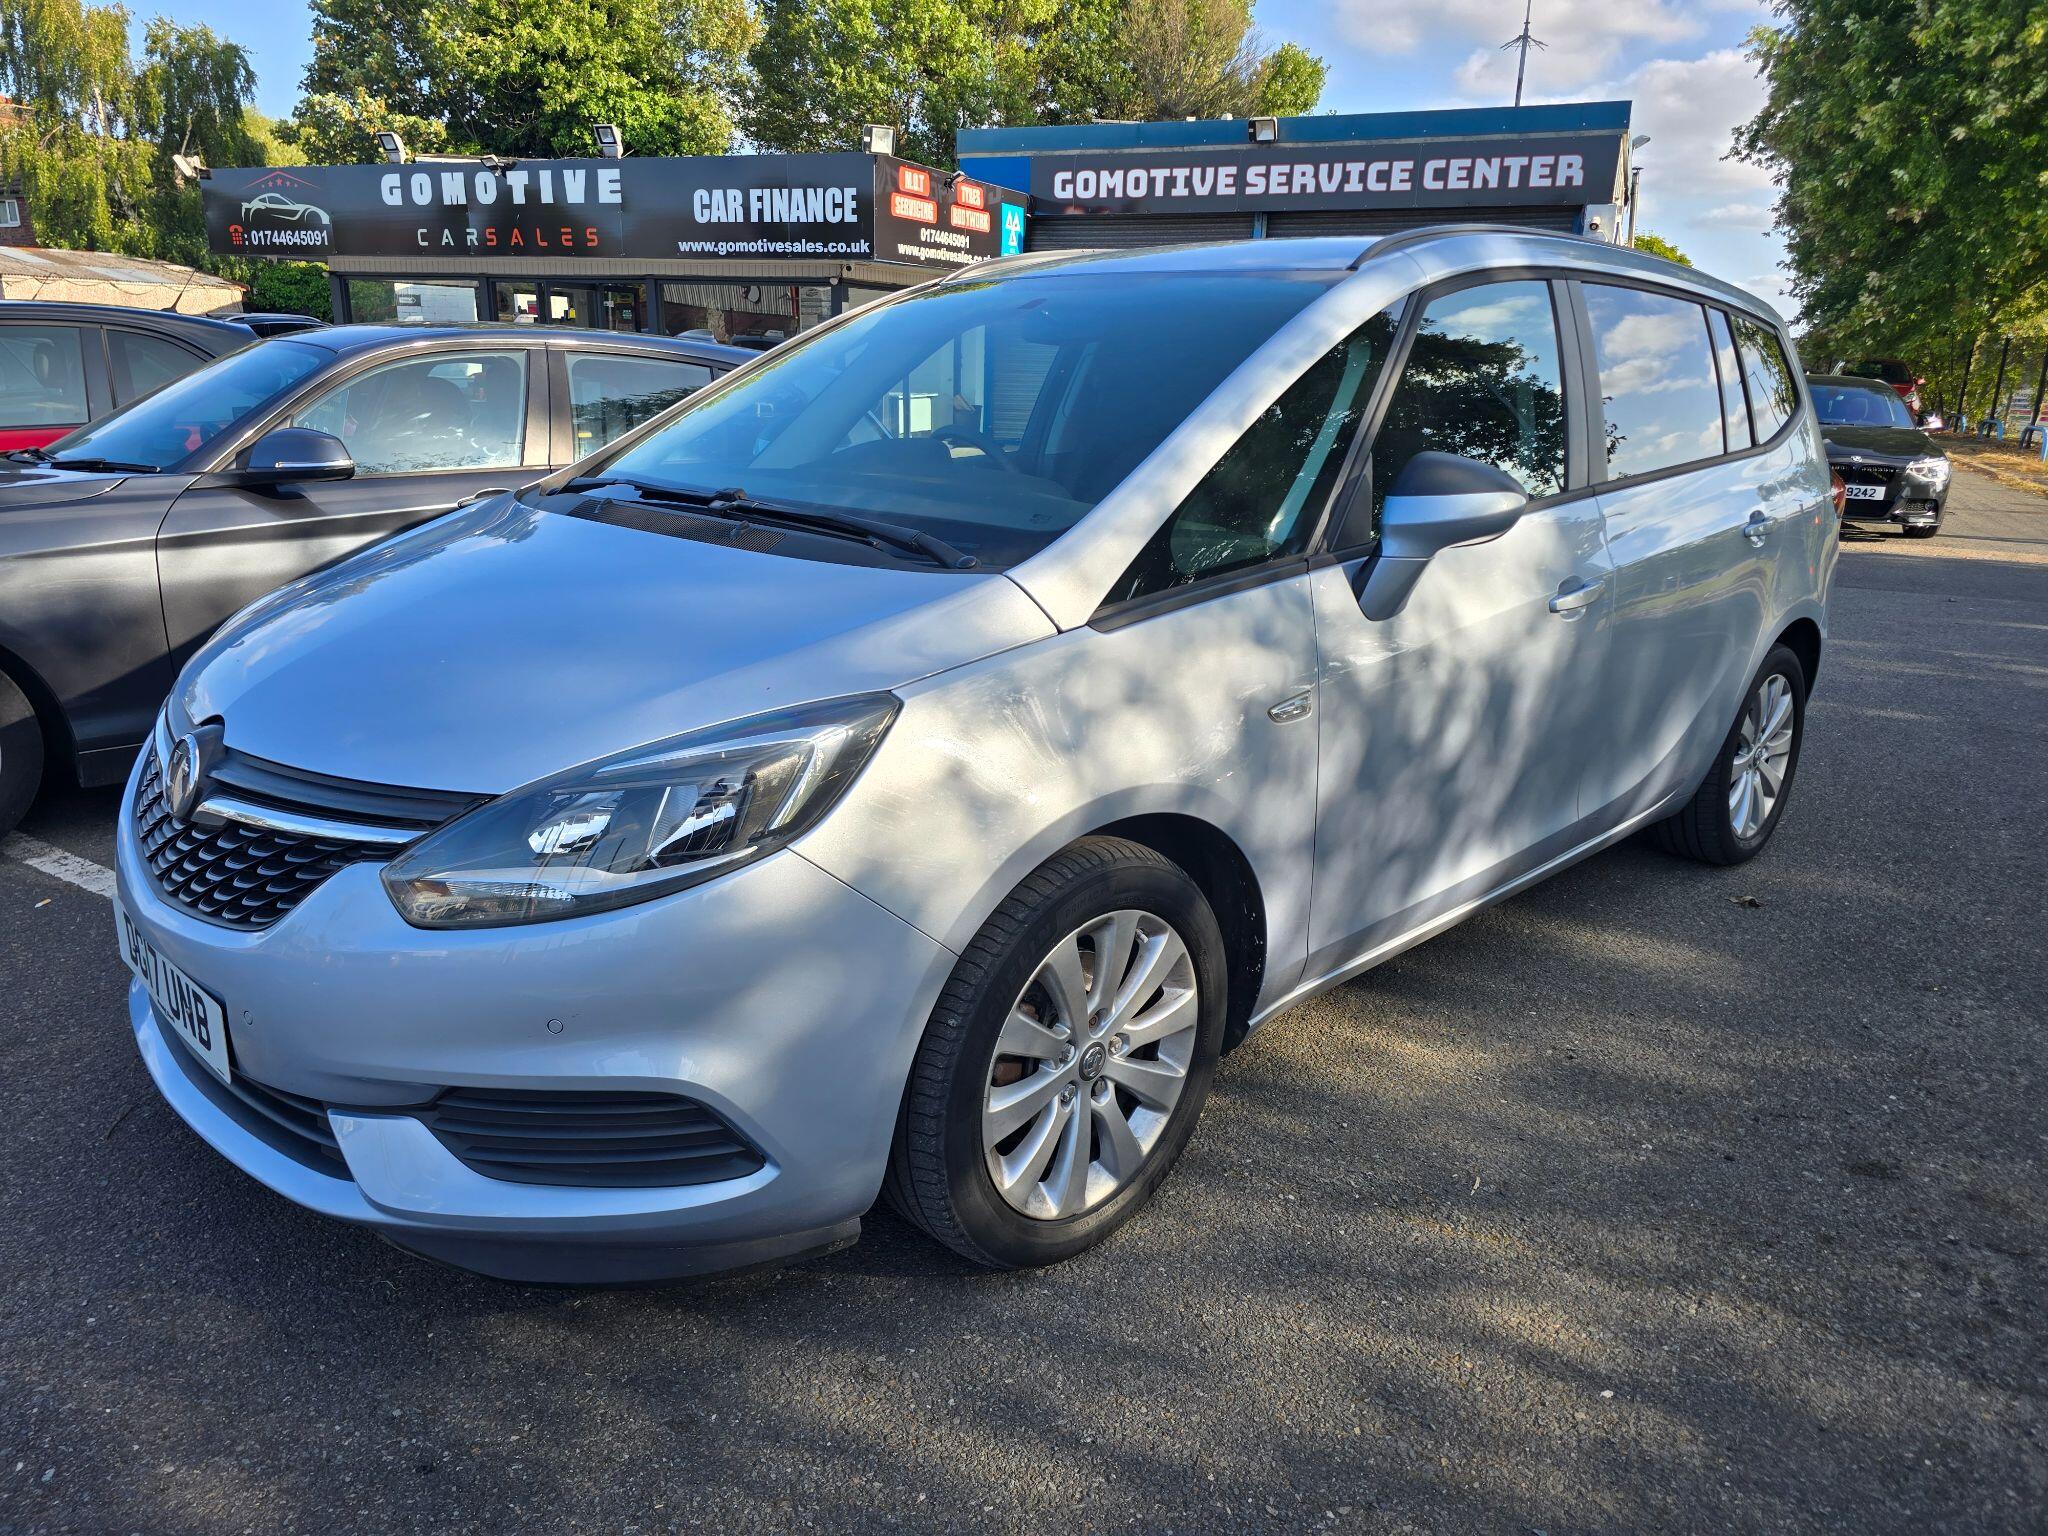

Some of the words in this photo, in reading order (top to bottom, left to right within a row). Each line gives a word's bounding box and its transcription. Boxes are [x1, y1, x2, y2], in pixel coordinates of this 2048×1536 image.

[380, 168, 623, 206] GOMOTIVE
[1053, 165, 1238, 200] GOMOTIVE
[1245, 161, 1414, 195] SERVICE
[1423, 155, 1584, 190] CENTER
[693, 188, 744, 224] CAR
[749, 187, 858, 224] FINANCE
[894, 195, 935, 223] SERVICING
[960, 185, 982, 207] TYRES
[952, 207, 988, 232] BODYWORK
[678, 238, 871, 256] www.gomotivesales.co.uk
[920, 228, 969, 248] 01744645091
[1846, 487, 1877, 498] 9242
[122, 910, 160, 998] DG17
[161, 959, 212, 1052] UNB
